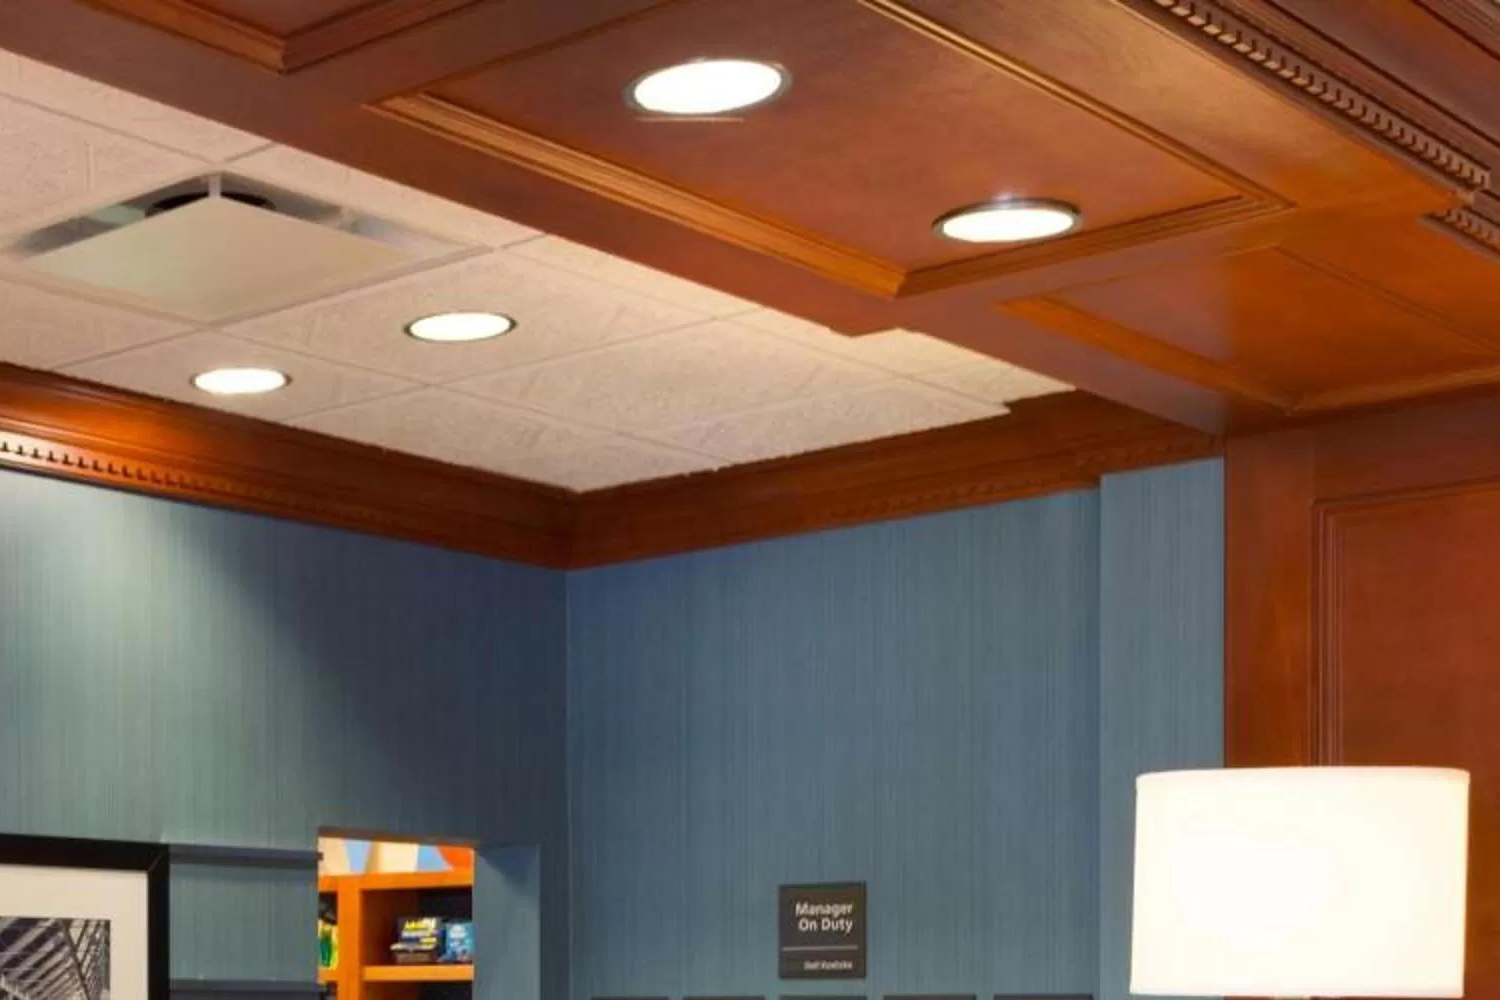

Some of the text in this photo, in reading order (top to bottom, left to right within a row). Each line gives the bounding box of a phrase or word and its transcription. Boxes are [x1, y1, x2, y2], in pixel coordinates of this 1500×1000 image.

[795, 902, 853, 918] Manager
[798, 917, 853, 935] On Duty
